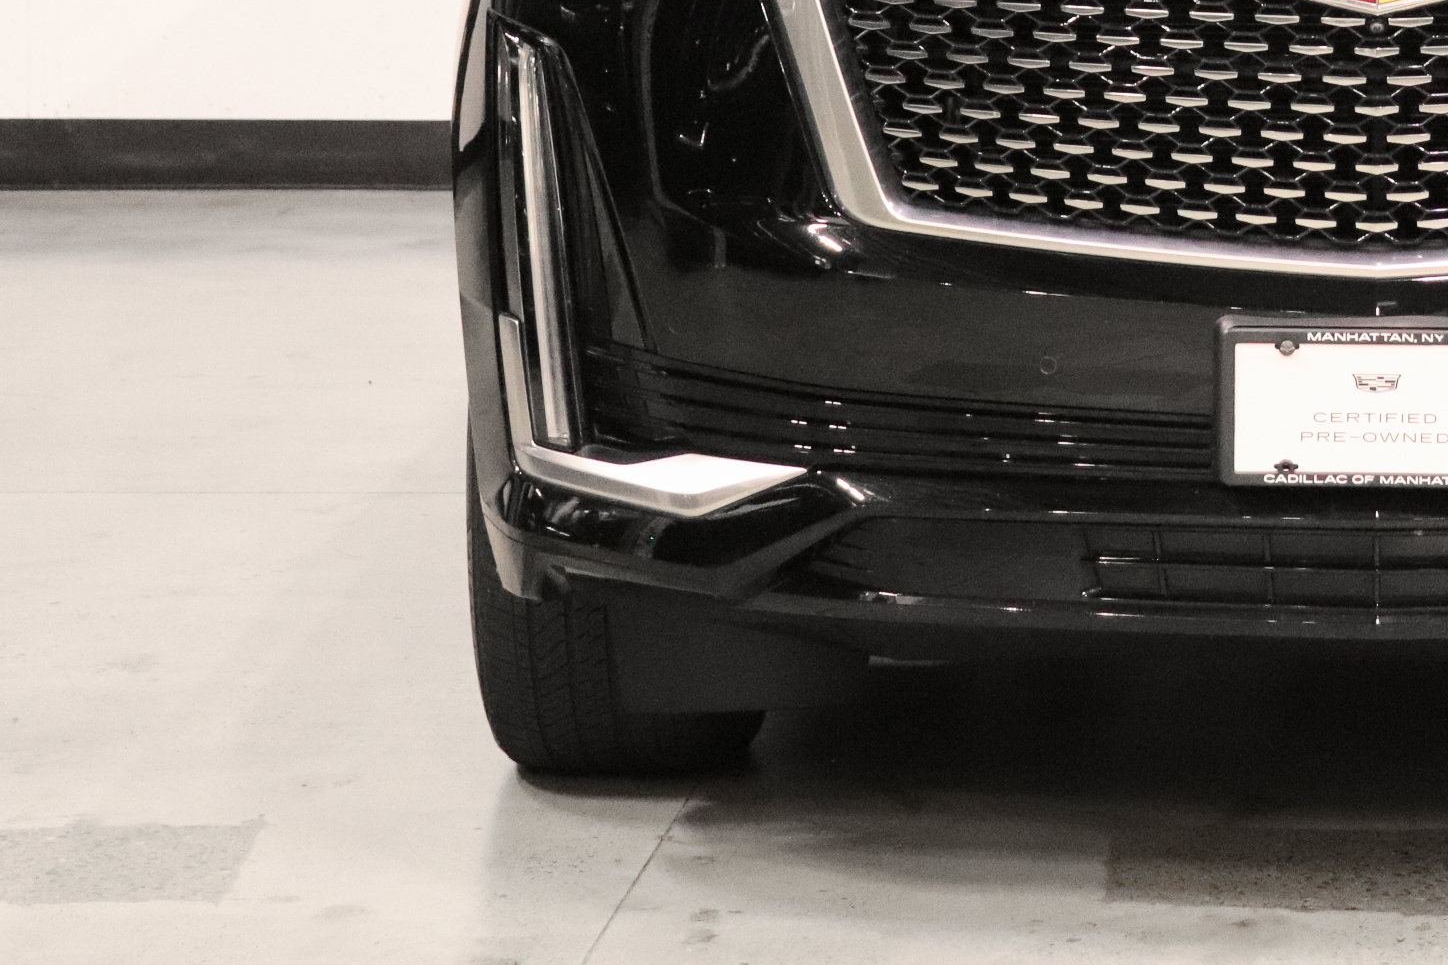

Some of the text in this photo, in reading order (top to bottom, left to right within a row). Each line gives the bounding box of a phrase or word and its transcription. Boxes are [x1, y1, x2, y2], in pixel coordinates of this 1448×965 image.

[1421, 333, 1444, 343] NY
[1313, 412, 1437, 424] CERTIFIED
[1263, 474, 1347, 485] CADILLAC
[1351, 475, 1375, 485] OF
